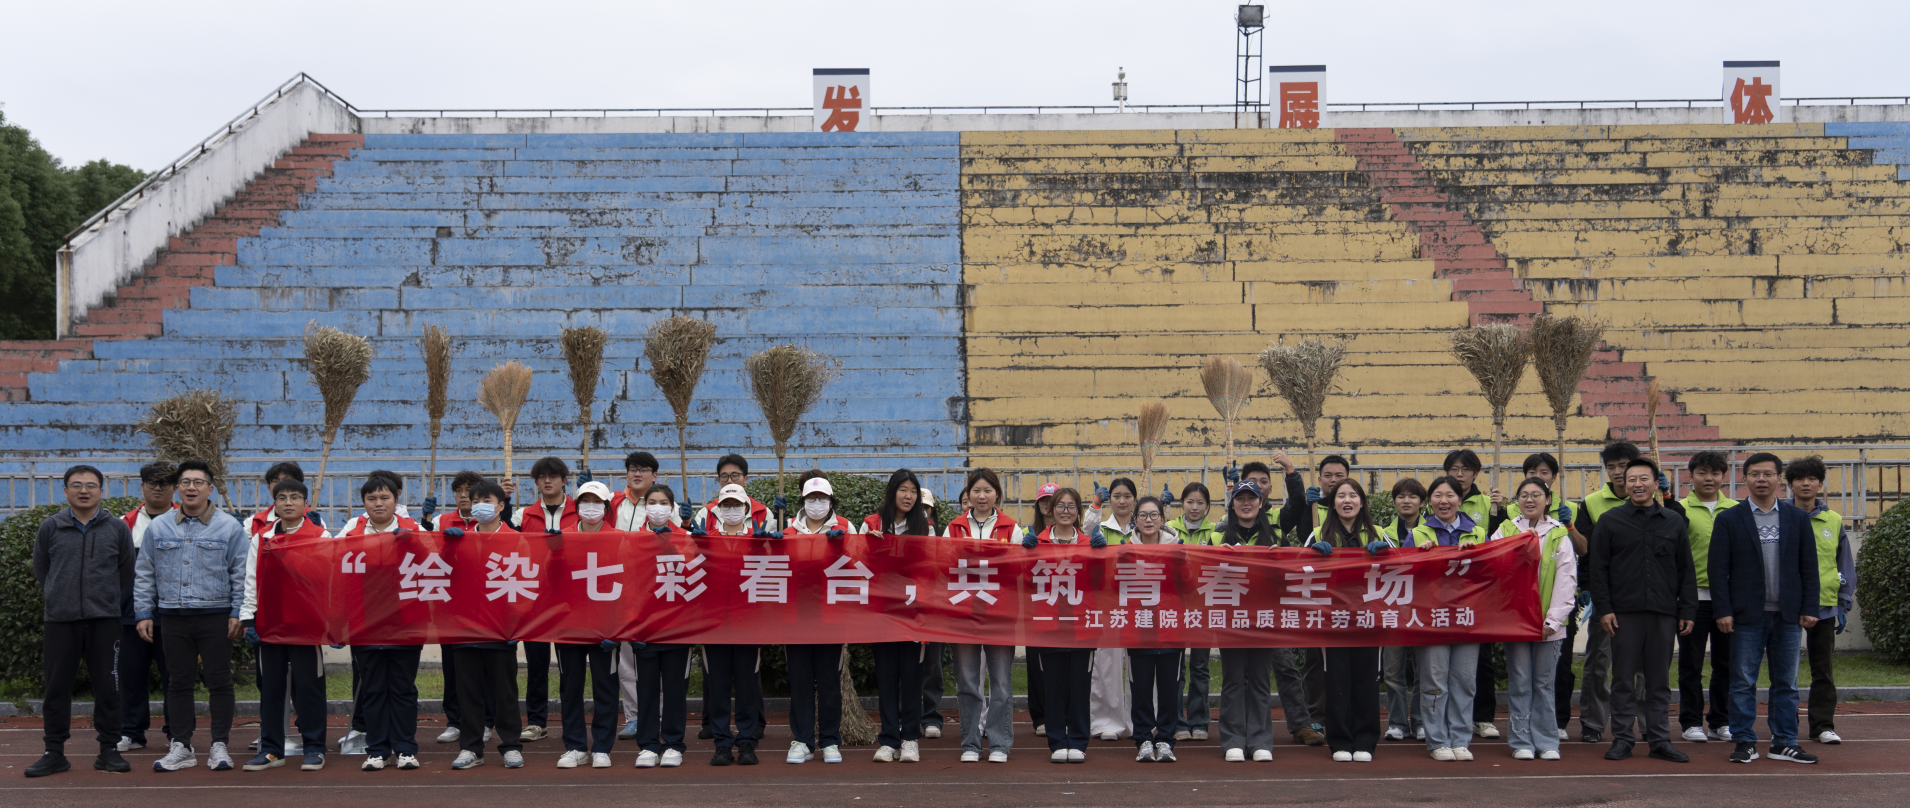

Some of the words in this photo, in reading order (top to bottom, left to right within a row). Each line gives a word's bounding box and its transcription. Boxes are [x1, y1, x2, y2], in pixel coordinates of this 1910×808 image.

[820, 84, 862, 133] 发
[1278, 81, 1320, 129] 展
[1729, 76, 1775, 125] 体
